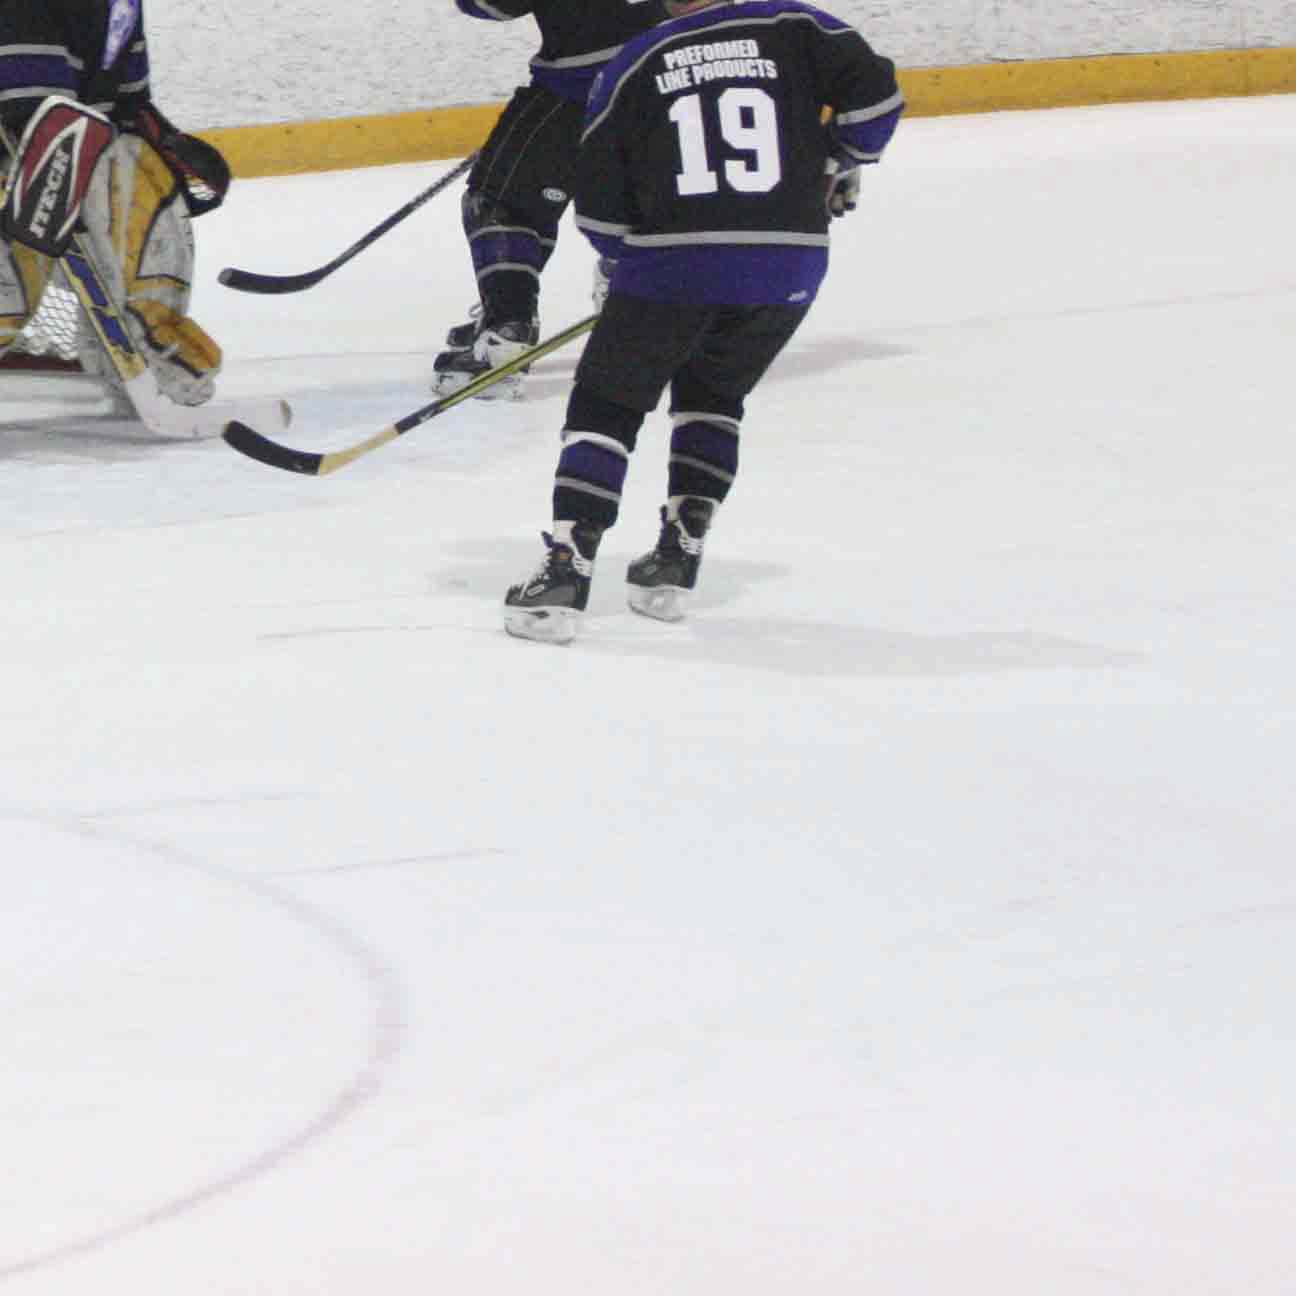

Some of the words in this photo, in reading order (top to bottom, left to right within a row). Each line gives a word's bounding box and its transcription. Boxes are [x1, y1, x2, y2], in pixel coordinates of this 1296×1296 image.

[664, 39, 759, 70] PREFORMED
[656, 67, 692, 94] LINE
[692, 59, 778, 85] PRODUCTS
[668, 88, 782, 195] 19
